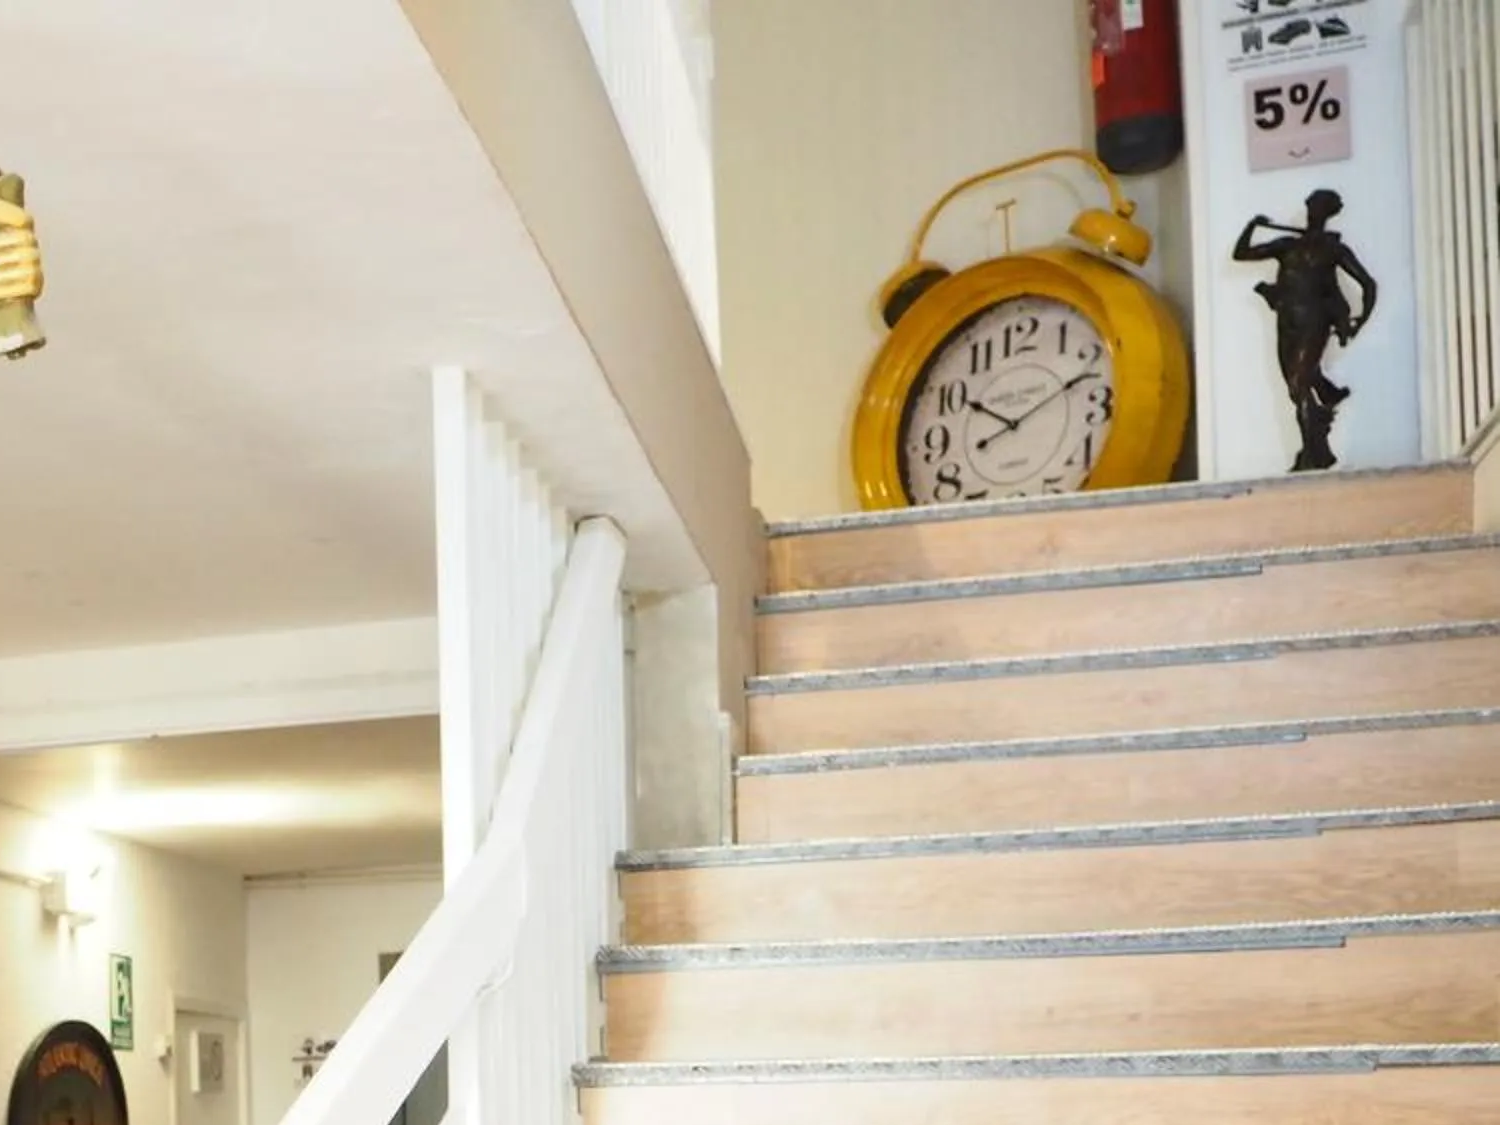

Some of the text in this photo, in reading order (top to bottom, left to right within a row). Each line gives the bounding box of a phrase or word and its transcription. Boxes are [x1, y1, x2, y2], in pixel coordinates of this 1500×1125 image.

[1253, 79, 1341, 131] 5%
[1003, 316, 1039, 358] 12
[1058, 320, 1068, 355] 1
[970, 338, 993, 375] 11
[1076, 342, 1103, 378] 2
[938, 379, 967, 417] 10
[1085, 385, 1114, 426] 3
[923, 424, 951, 465] 9
[933, 462, 963, 500] 8
